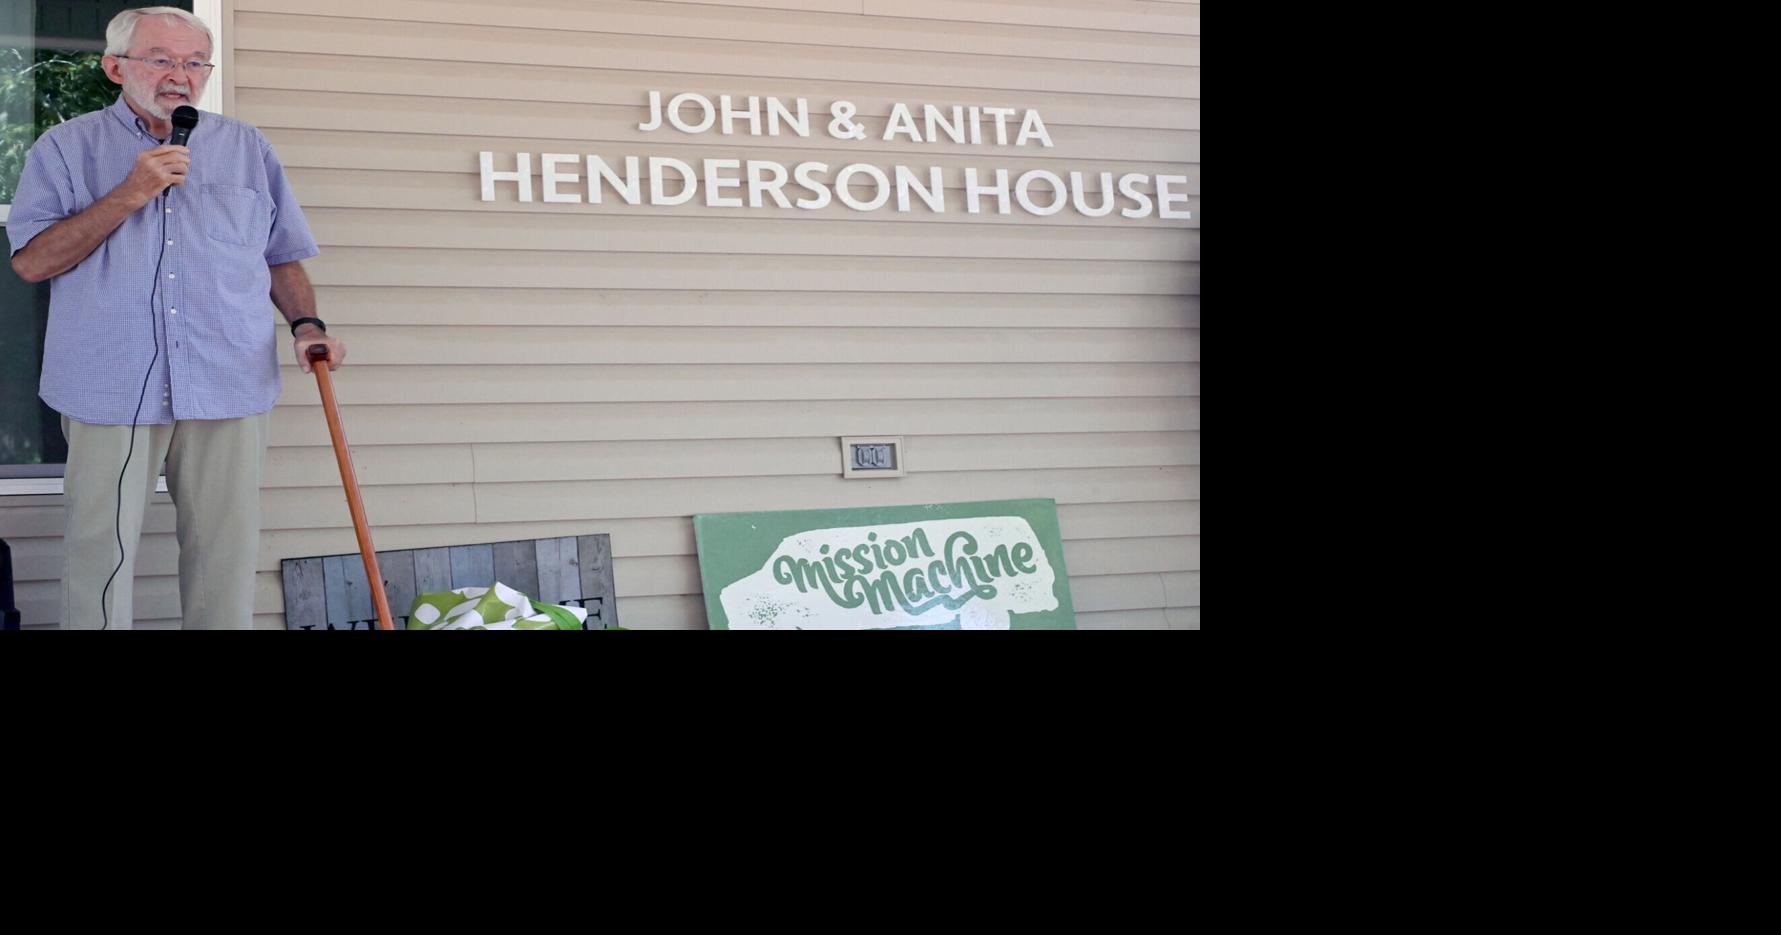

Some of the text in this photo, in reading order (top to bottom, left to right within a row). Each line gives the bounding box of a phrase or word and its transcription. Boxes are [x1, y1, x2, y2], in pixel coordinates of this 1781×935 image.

[639, 91, 1054, 148] JOHN & ANITA
[479, 151, 1192, 220] HENDERSON HOUSE
